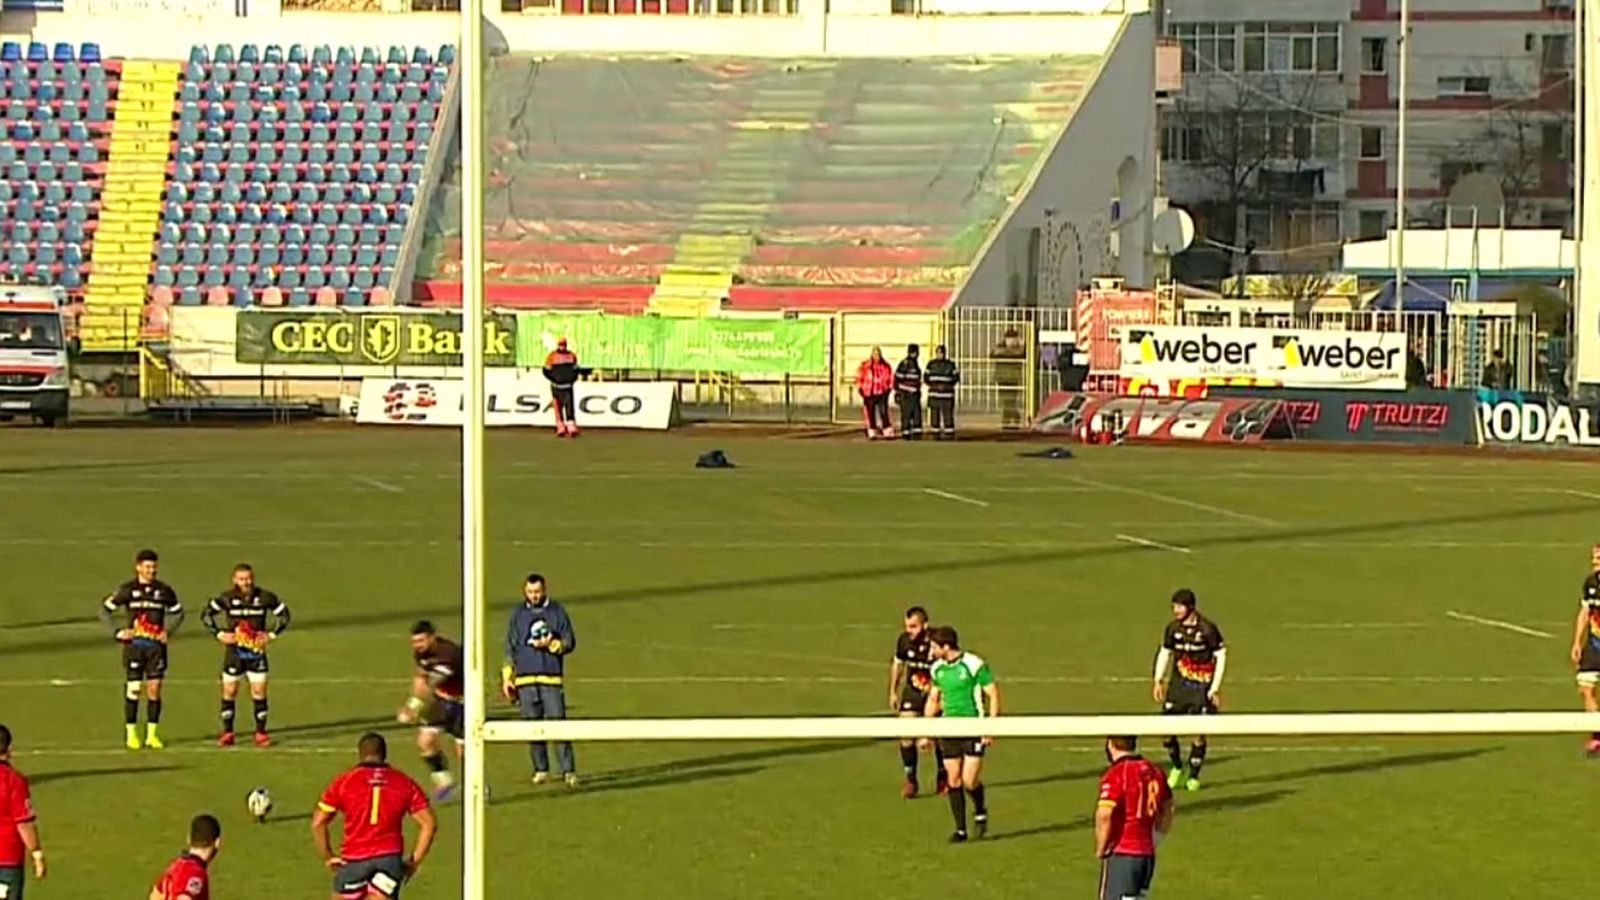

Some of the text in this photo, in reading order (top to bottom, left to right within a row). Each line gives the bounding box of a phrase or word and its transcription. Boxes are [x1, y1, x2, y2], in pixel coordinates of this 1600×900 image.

[271, 321, 354, 353] CEC
[1153, 333, 1257, 365] weber
[1296, 337, 1400, 370] weber
[459, 393, 643, 417] LSCO
[1372, 403, 1449, 425] TRUTZI
[369, 785, 381, 826] 1
[1135, 779, 1160, 819] 18
